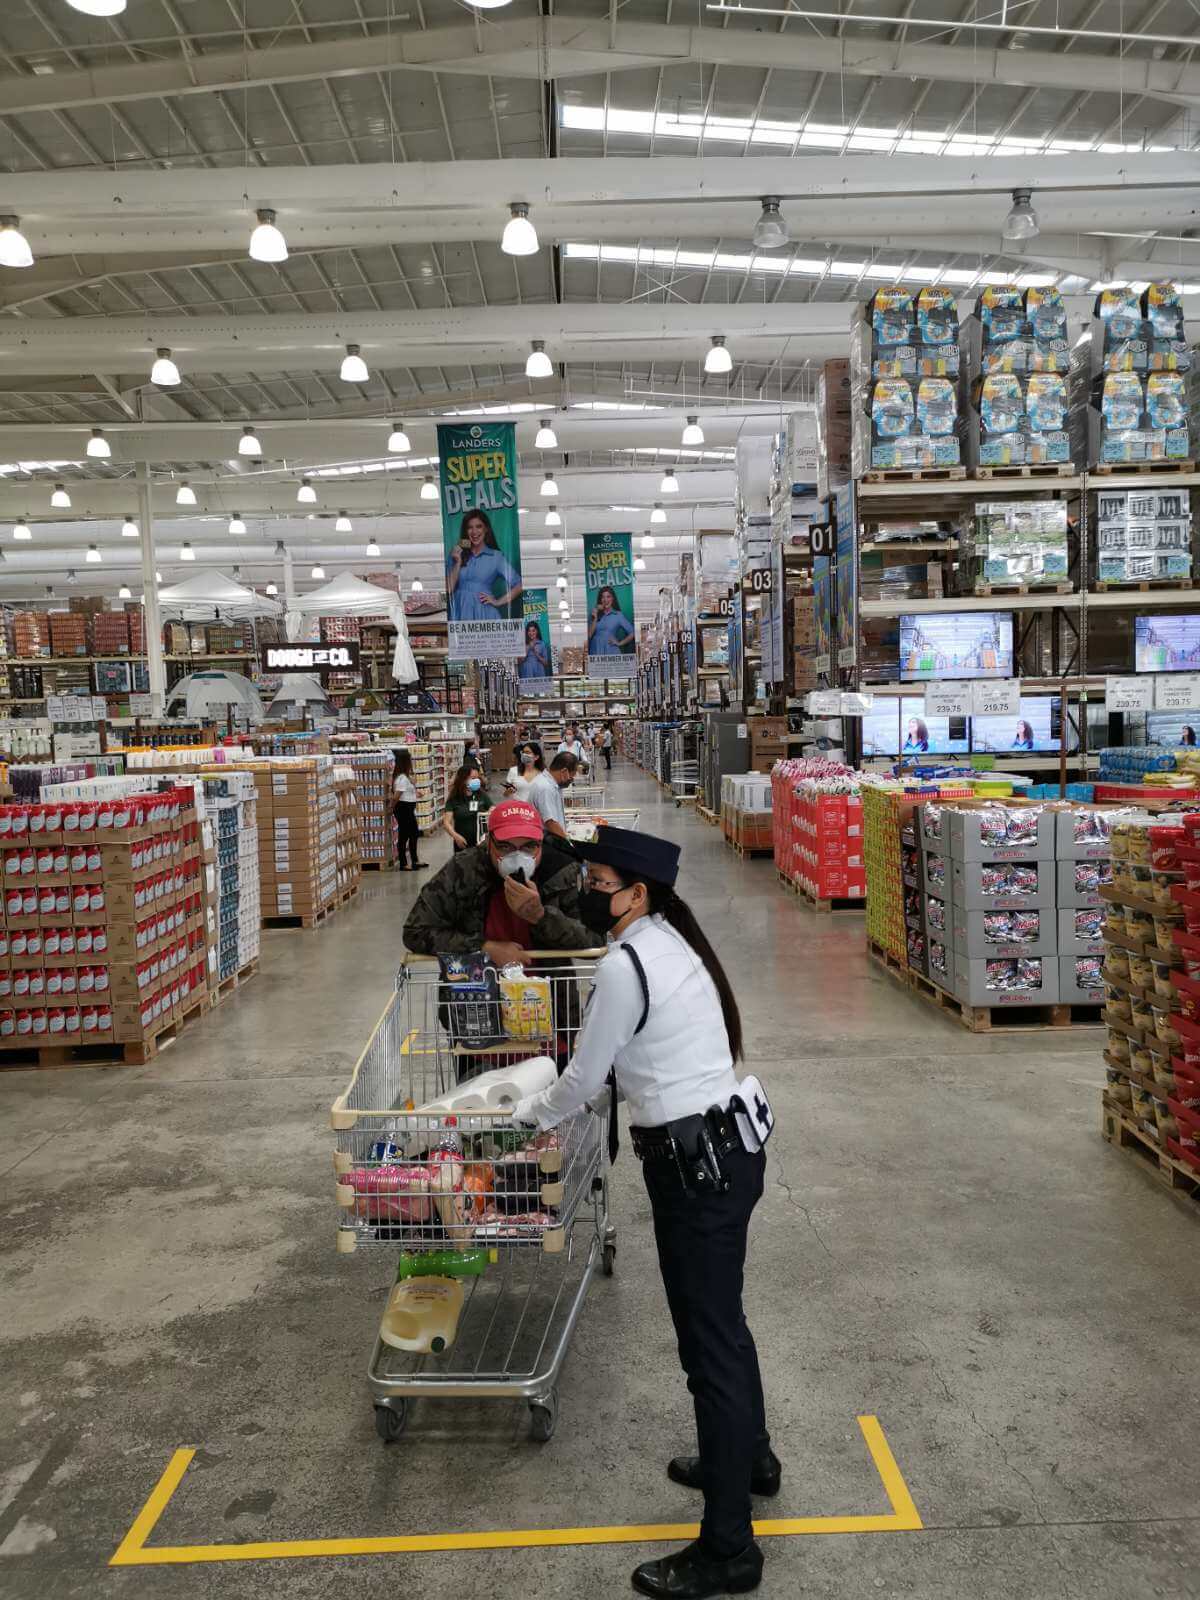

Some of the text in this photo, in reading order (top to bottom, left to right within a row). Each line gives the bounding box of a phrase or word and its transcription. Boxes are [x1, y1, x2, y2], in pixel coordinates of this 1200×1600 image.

[452, 439, 501, 449] LANDERS
[447, 452, 508, 483] SUPER
[444, 478, 516, 514] DEALS
[811, 525, 833, 552] 01
[589, 551, 627, 570] SUPER
[588, 567, 632, 589] DEALS
[753, 571, 771, 590] 03
[720, 600, 735, 615] 05
[449, 623, 460, 633] BE
[461, 623, 467, 633] A
[468, 622, 500, 633] MEMBER
[681, 632, 692, 643] 09
[502, 807, 535, 818] CANADA
